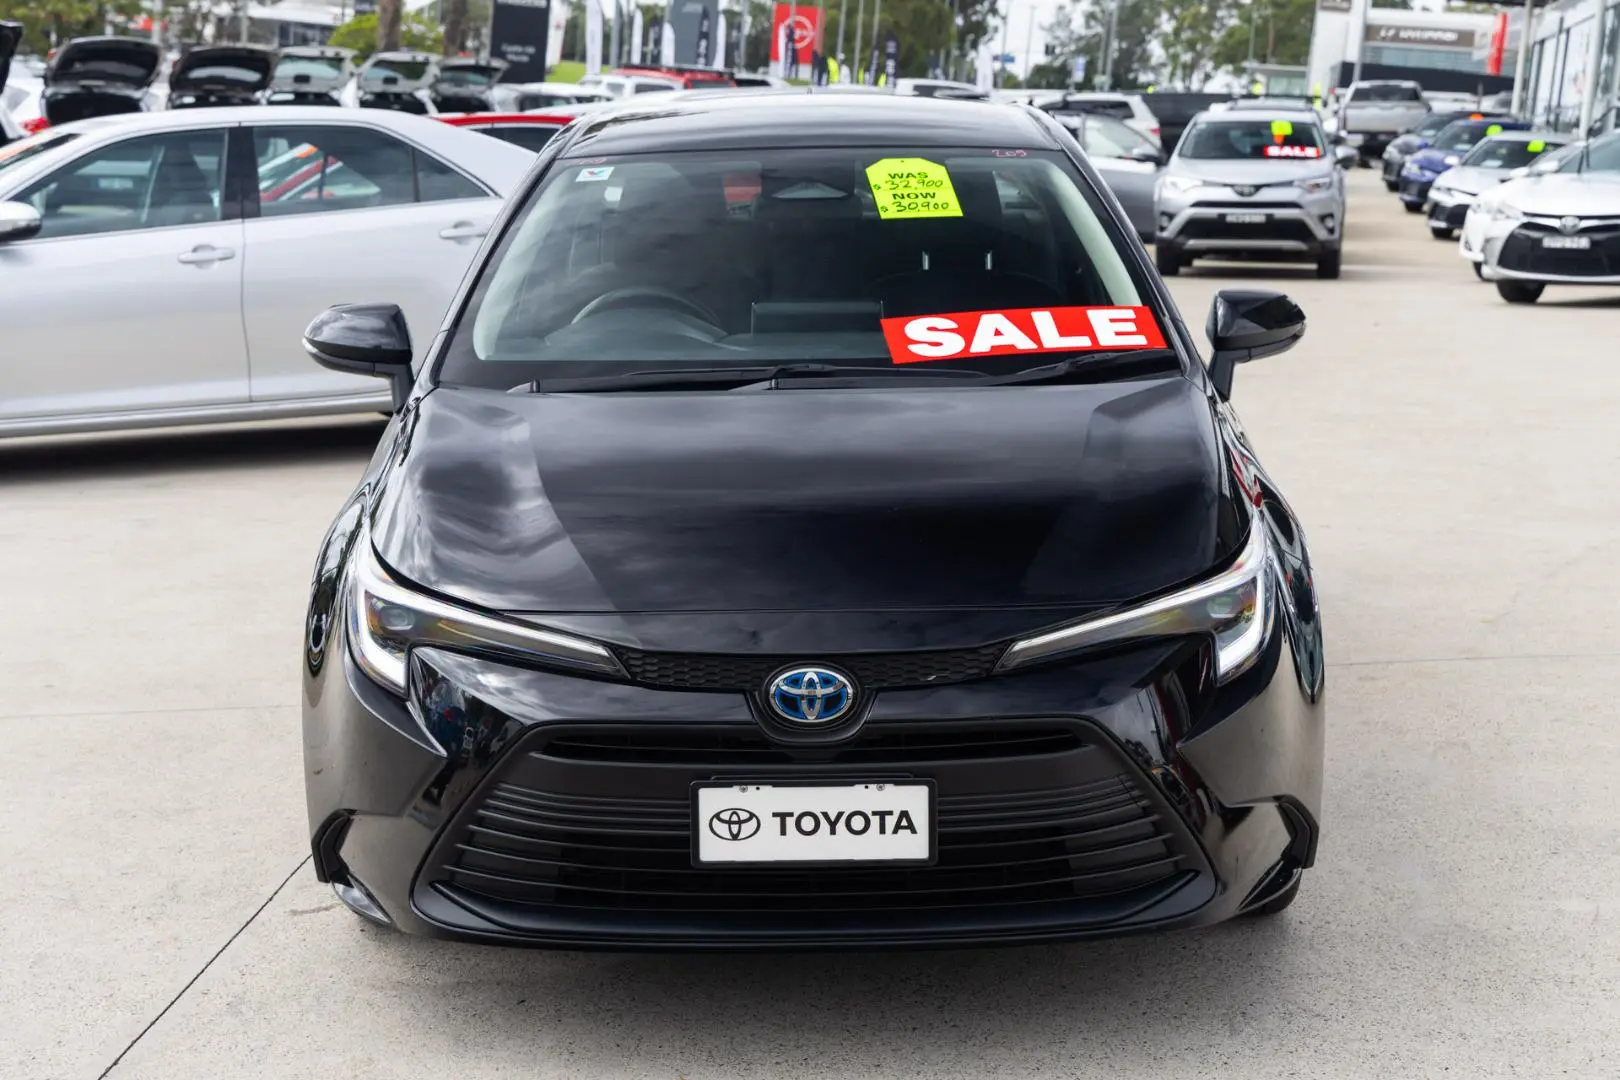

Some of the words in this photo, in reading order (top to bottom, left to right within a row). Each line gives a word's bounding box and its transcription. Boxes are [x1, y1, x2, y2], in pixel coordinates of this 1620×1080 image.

[888, 171, 929, 179] WAS
[892, 192, 936, 200] NOW
[904, 309, 1148, 357] SALE
[772, 809, 918, 837] TOYOTA
